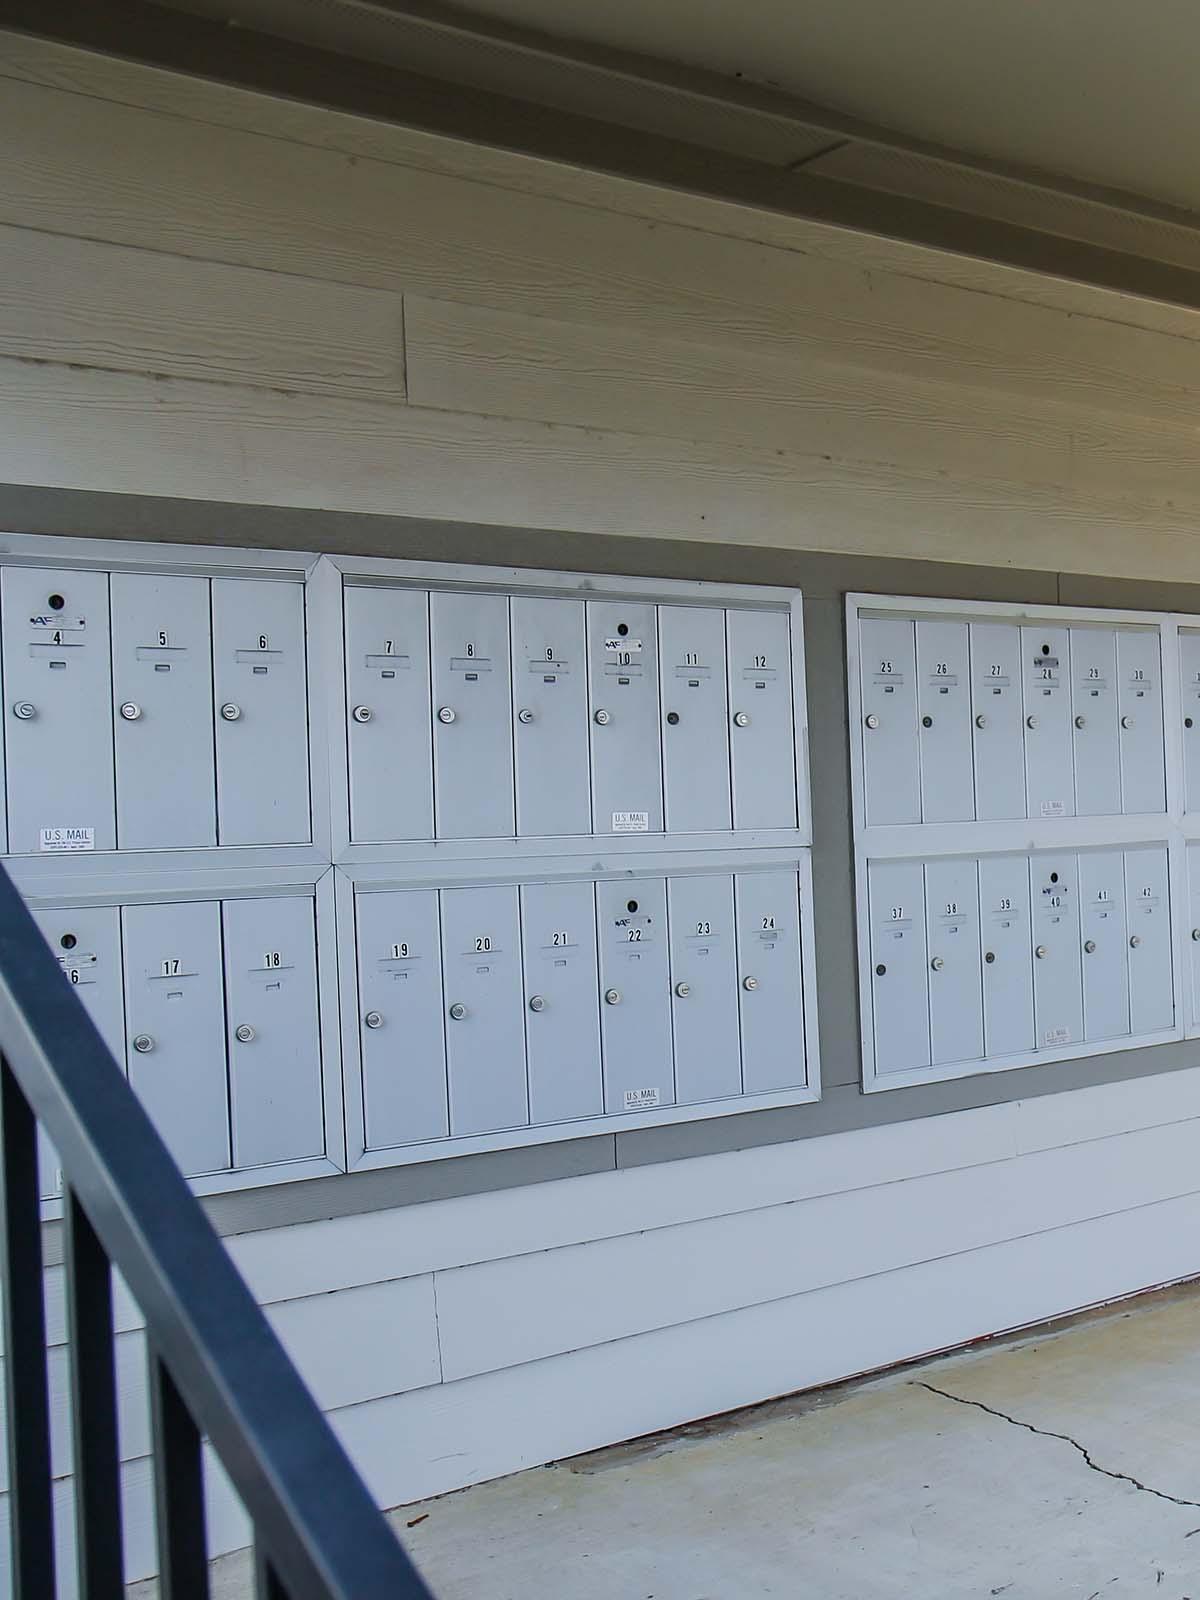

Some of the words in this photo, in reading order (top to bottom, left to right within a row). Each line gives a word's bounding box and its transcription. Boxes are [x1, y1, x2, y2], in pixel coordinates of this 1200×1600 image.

[53, 631, 60, 645] 4
[159, 632, 166, 646] 5
[259, 635, 266, 649] 6
[386, 641, 392, 653] 7
[467, 644, 473, 656] 8
[547, 648, 553, 660] 9
[618, 653, 630, 665] 10
[686, 653, 697, 665] 11
[755, 656, 766, 667] 12
[881, 662, 892, 673] 25
[937, 663, 947, 674] 26
[991, 665, 1001, 676] 27
[615, 813, 627, 822] U.S.
[629, 813, 645, 822] MAIL
[45, 830, 64, 841] U.S.
[66, 829, 89, 840] MAIL
[947, 903, 956, 914] 38
[1001, 899, 1010, 910] 39
[892, 907, 902, 919] 37
[697, 922, 710, 934] 23
[762, 917, 774, 929] 24
[553, 933, 567, 946] 21
[628, 930, 641, 942] 22
[394, 943, 407, 957] 19
[476, 938, 490, 951] 20
[265, 953, 280, 967] 18
[164, 960, 179, 975] 17
[626, 1092, 638, 1101] U.S.
[640, 1089, 656, 1098] MAIL
